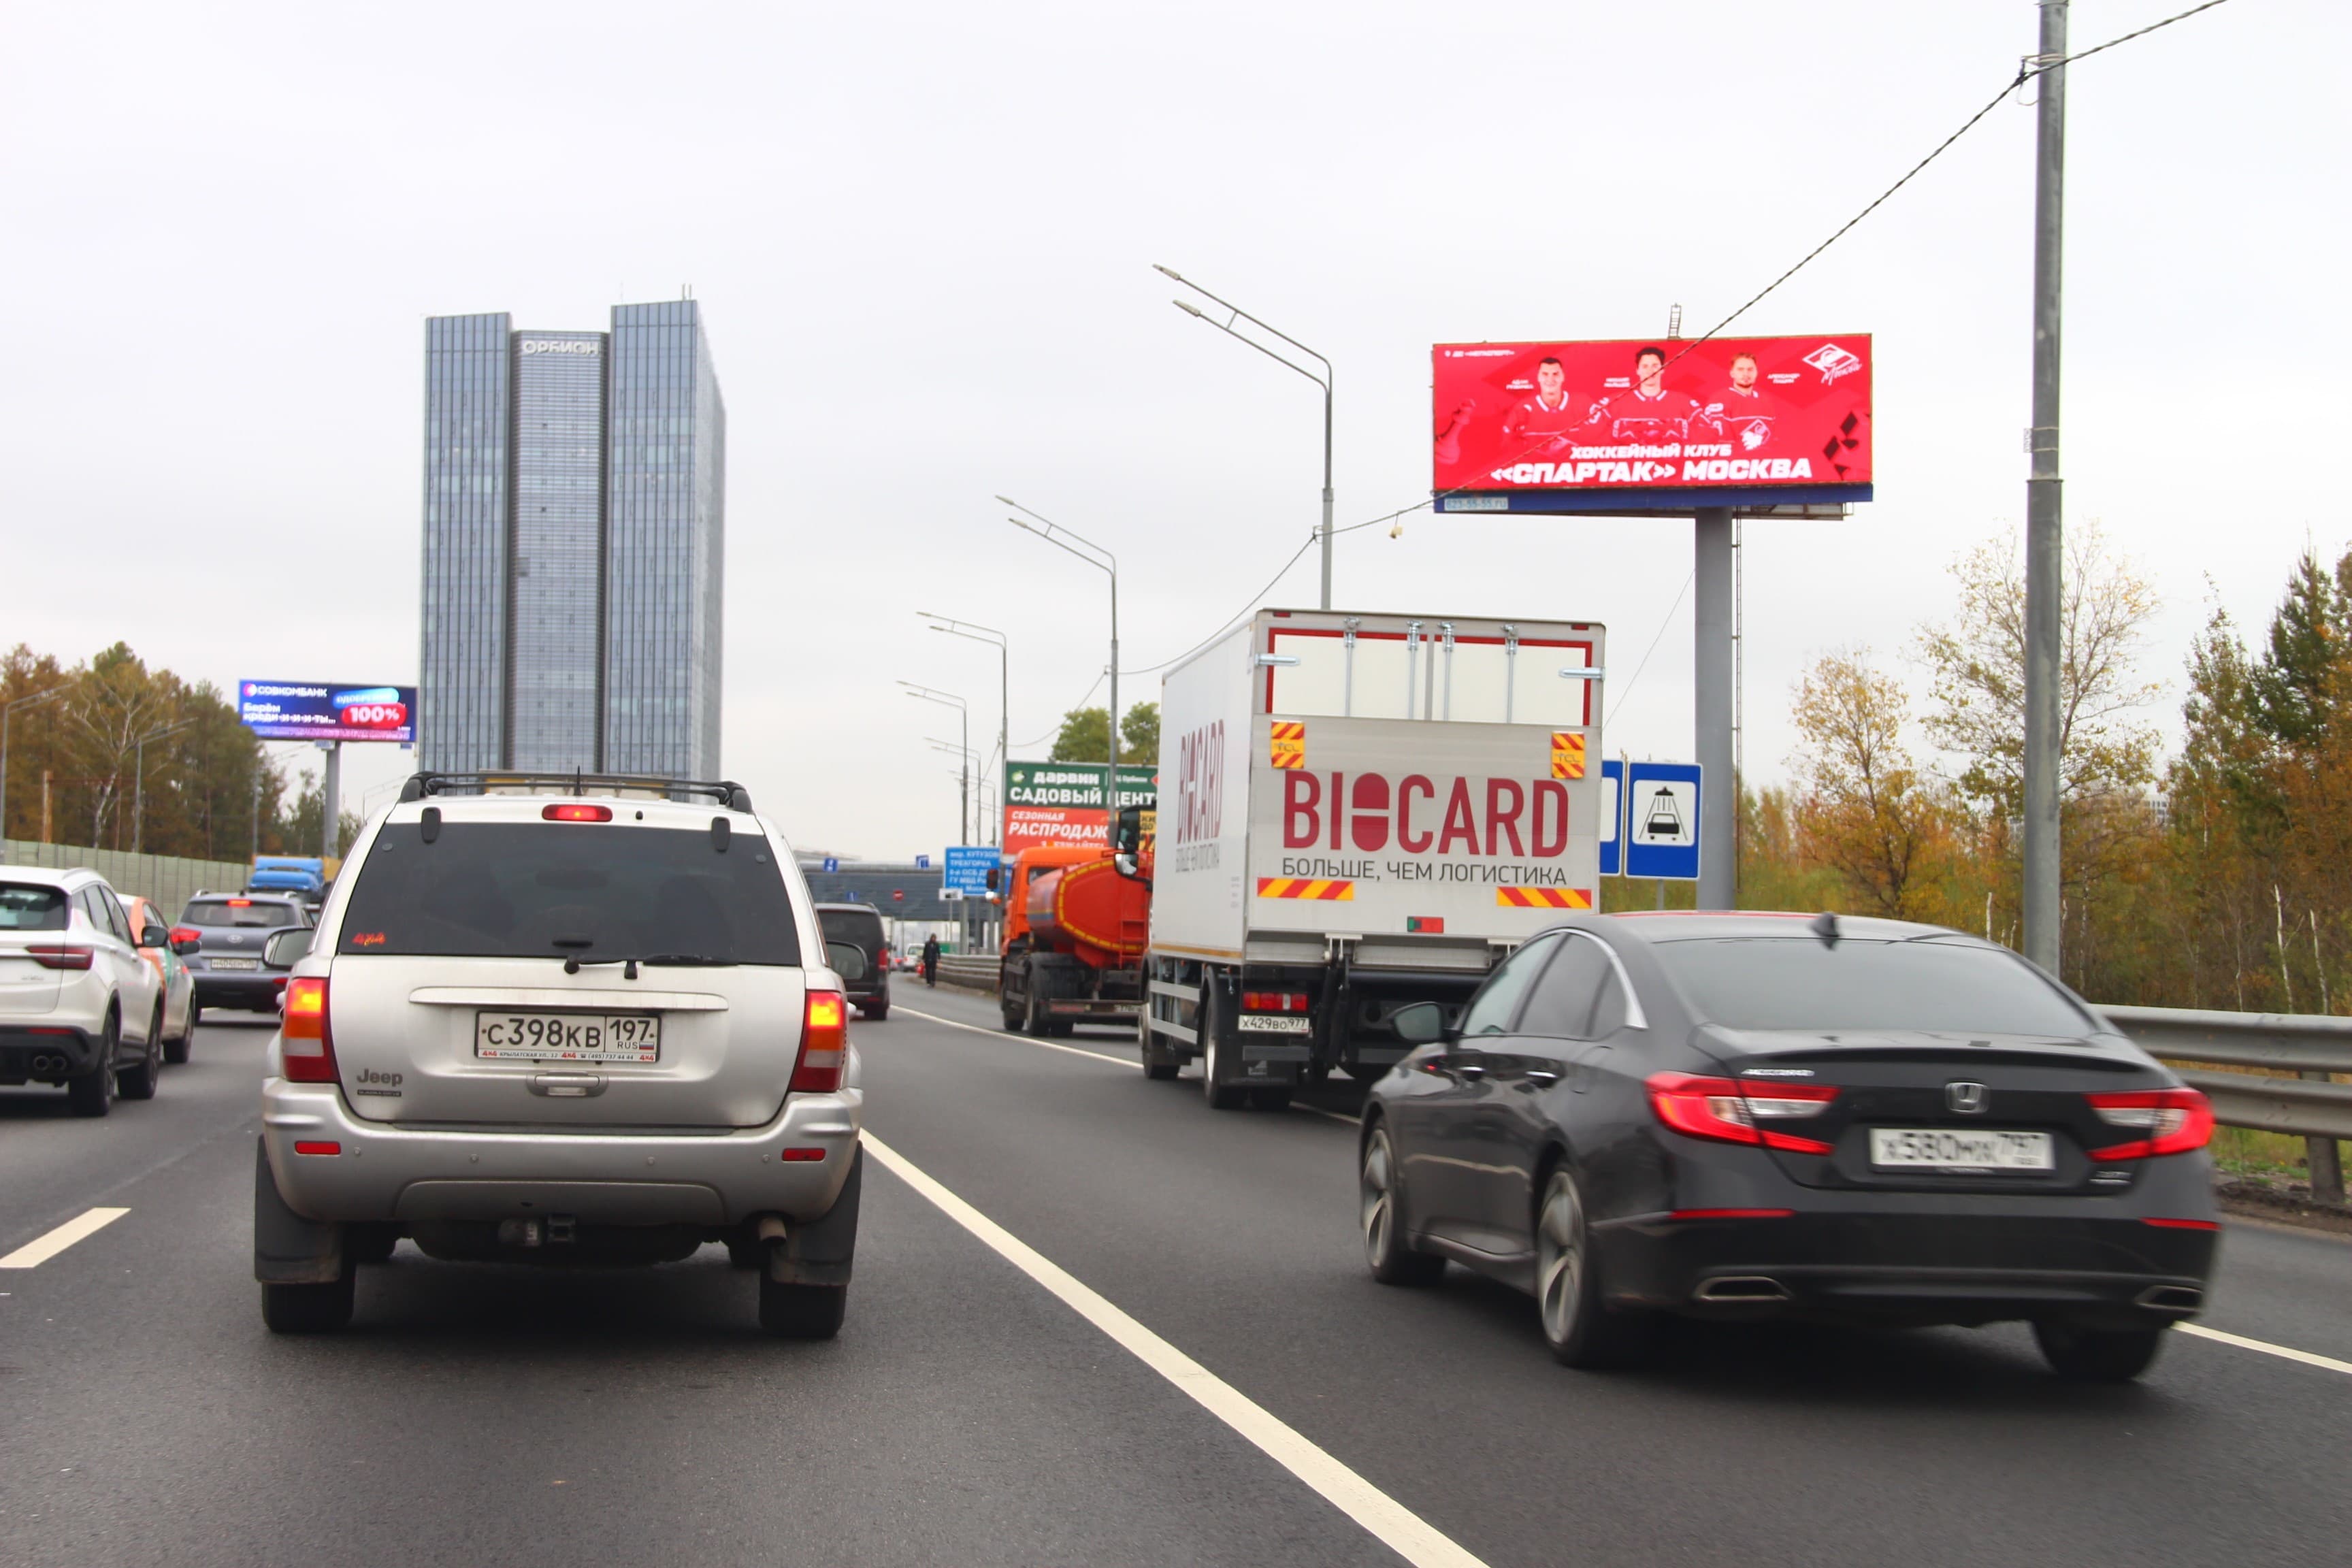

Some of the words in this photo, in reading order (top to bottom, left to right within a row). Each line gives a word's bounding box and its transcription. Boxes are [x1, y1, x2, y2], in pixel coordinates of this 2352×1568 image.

[523, 340, 599, 355] ОРБИОН
[1570, 444, 1681, 459] ХОККЕЙНЫЙ
[1684, 444, 1732, 457] КЛУБ
[1490, 461, 1676, 484] «СПАРТАК»
[1682, 458, 1812, 480] МОСКВА
[257, 686, 327, 698] СОВКОМБАНК
[243, 702, 281, 713] Берём
[350, 706, 400, 723] 100%
[1033, 771, 1099, 785] дарвин
[1010, 787, 1102, 806] САДОВЫЙ
[1107, 791, 1158, 808] ЦЕНТ
[1011, 810, 1066, 822] СЕЗОННАЯ
[1283, 769, 1569, 858] BIOCARD
[1009, 821, 1109, 839] РАСПРОДАЖ
[1282, 858, 1380, 881] БОЛЬШЕ,
[1387, 862, 1432, 880] ЧЕМ
[1439, 864, 1567, 885] ЛОГИСТИКА
[1243, 1017, 1288, 1030] Х429ВО
[1289, 1017, 1306, 1027] 977
[487, 1018, 601, 1049] С398КВ
[610, 1019, 651, 1041] 197
[617, 1041, 638, 1049] RUS
[357, 1068, 403, 1087] Jeep
